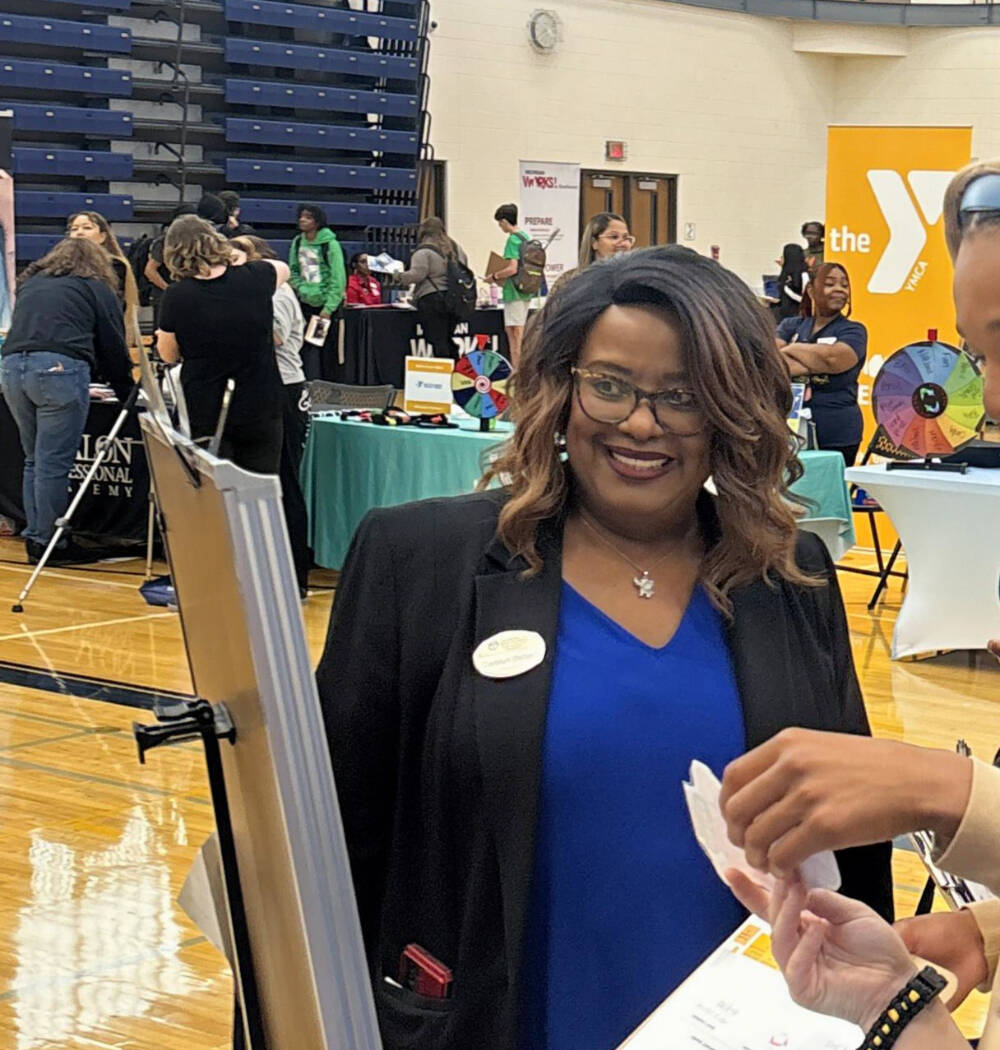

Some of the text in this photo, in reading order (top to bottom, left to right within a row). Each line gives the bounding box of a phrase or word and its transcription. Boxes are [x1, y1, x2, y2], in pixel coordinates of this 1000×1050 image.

[525, 217, 553, 226] PREPARE
[830, 225, 871, 253] the
[905, 260, 929, 293] YMCA
[75, 434, 133, 464] LON
